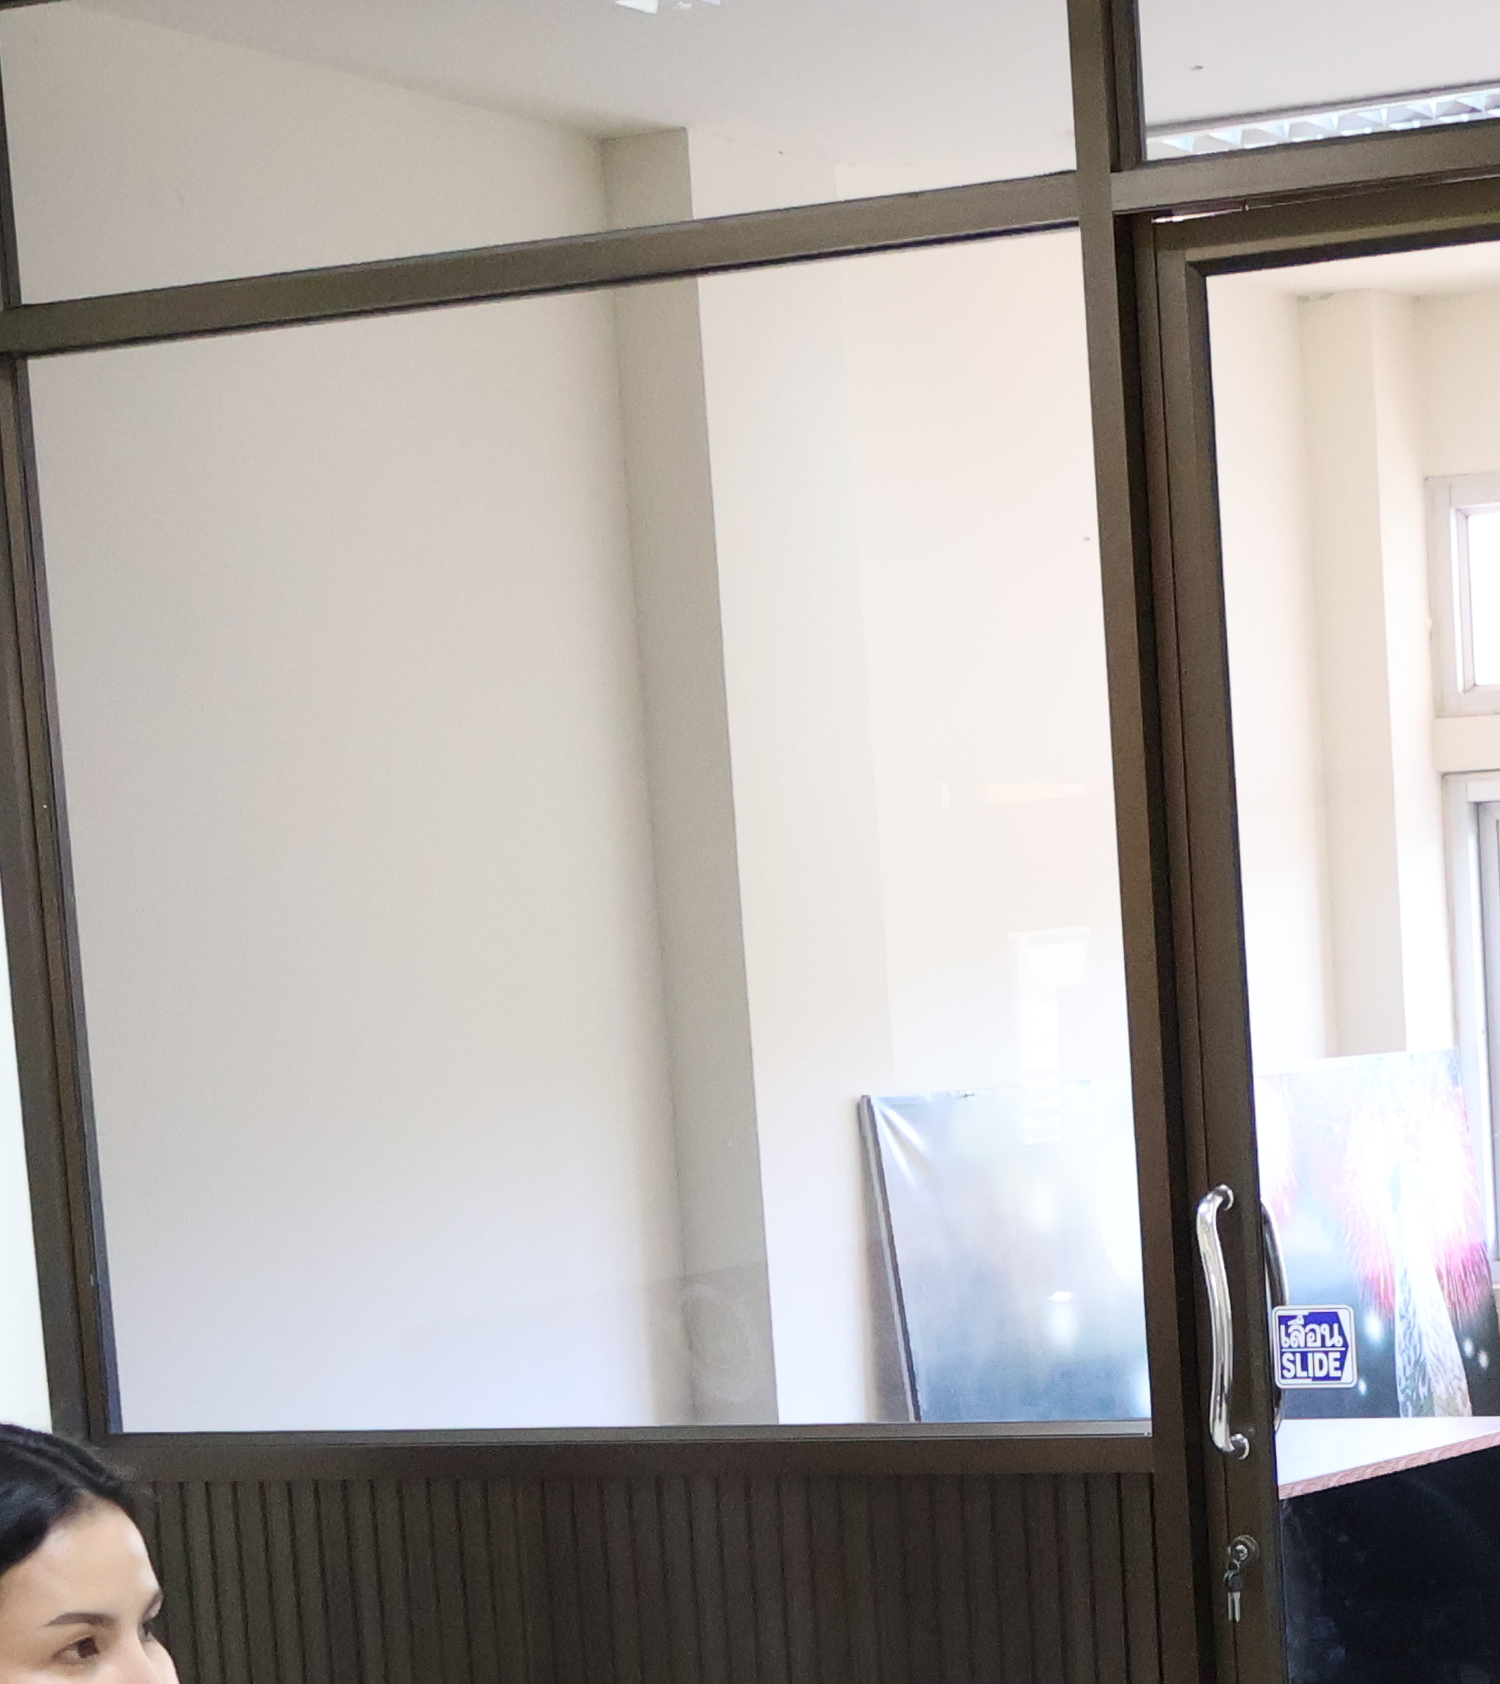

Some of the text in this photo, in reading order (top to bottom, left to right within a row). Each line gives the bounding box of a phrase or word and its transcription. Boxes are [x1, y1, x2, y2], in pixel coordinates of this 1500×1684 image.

[1280, 1314, 1343, 1348] เลื่อน
[1281, 1352, 1342, 1378] SLIDE
